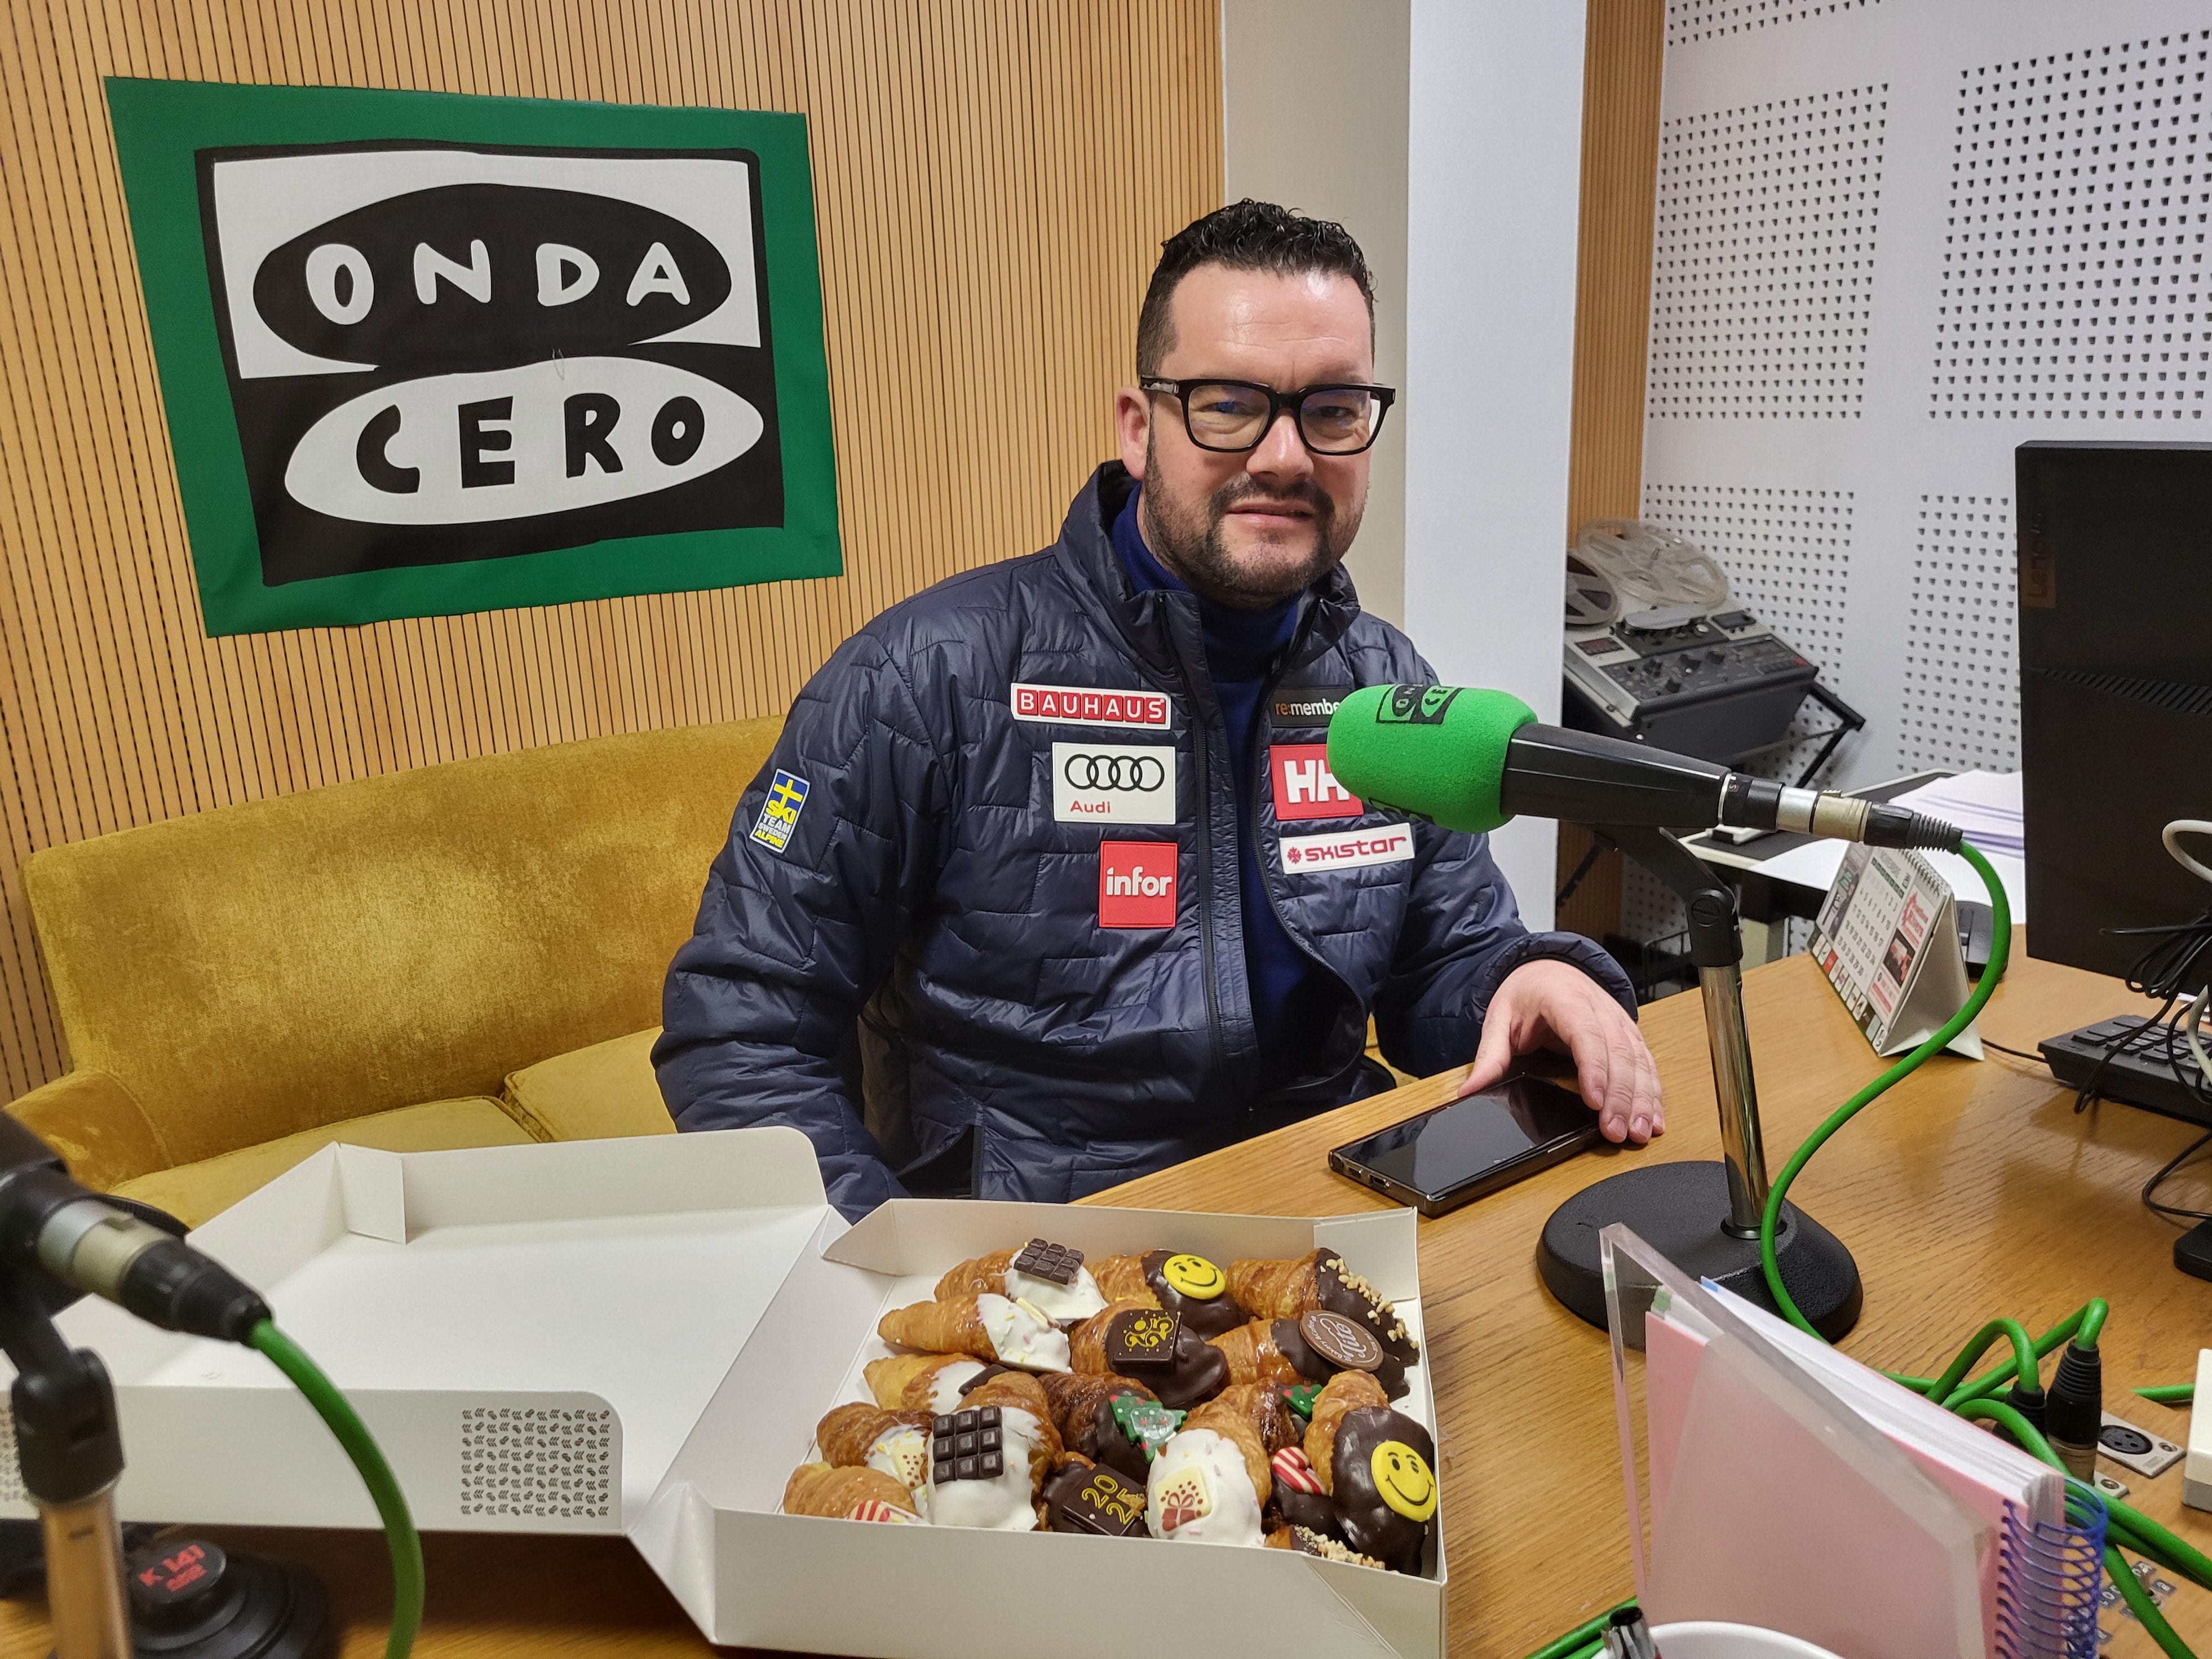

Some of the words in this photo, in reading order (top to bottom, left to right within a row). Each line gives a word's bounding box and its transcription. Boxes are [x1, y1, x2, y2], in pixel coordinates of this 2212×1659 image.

[306, 238, 691, 325] ONDA
[356, 392, 705, 494] CERO
[1020, 692, 1163, 719] BAUHAUS
[1275, 698, 1340, 716] re:membe
[1284, 759, 1350, 804] HH
[766, 800, 797, 825] SKI
[1070, 800, 1111, 814] Audi
[758, 822, 788, 840] SWEDEN
[763, 813, 792, 834] TEAM
[755, 830, 785, 848] ALPINE
[1106, 866, 1173, 897] infor
[1319, 1318, 1367, 1358] Tito
[1320, 1340, 1343, 1359] Bakery
